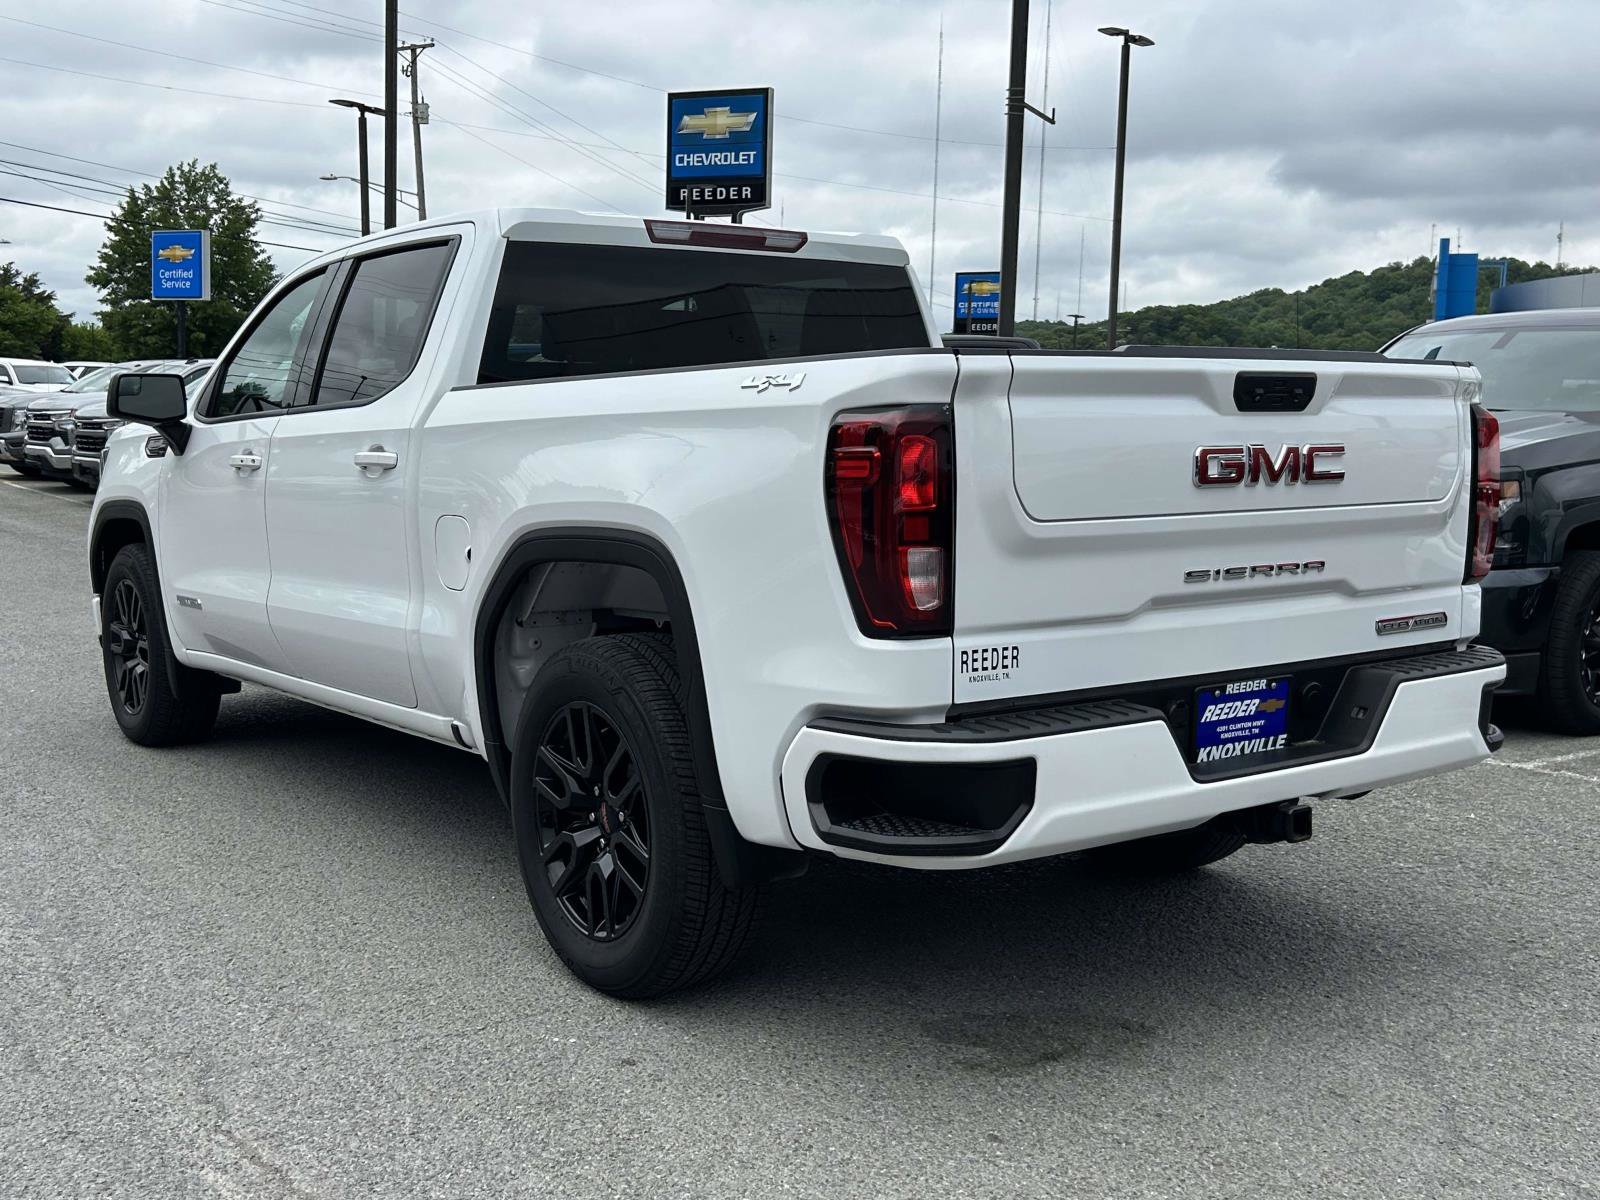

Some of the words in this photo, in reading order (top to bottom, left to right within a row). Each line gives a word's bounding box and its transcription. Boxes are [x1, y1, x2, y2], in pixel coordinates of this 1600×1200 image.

[675, 151, 756, 167] CHEVROLET
[680, 186, 752, 201] REEDER
[159, 269, 193, 279] Certified
[161, 279, 191, 289] Service
[1192, 443, 1346, 489] GMC
[1184, 560, 1326, 583] SIERRA
[961, 646, 1019, 673] REEDER
[969, 674, 1000, 683] KNOXVILLE,
[1226, 679, 1267, 694] REEDER
[1200, 699, 1261, 723] REEDER
[1229, 721, 1252, 730] CLINTON
[1197, 734, 1287, 763] KNOXVILLE
